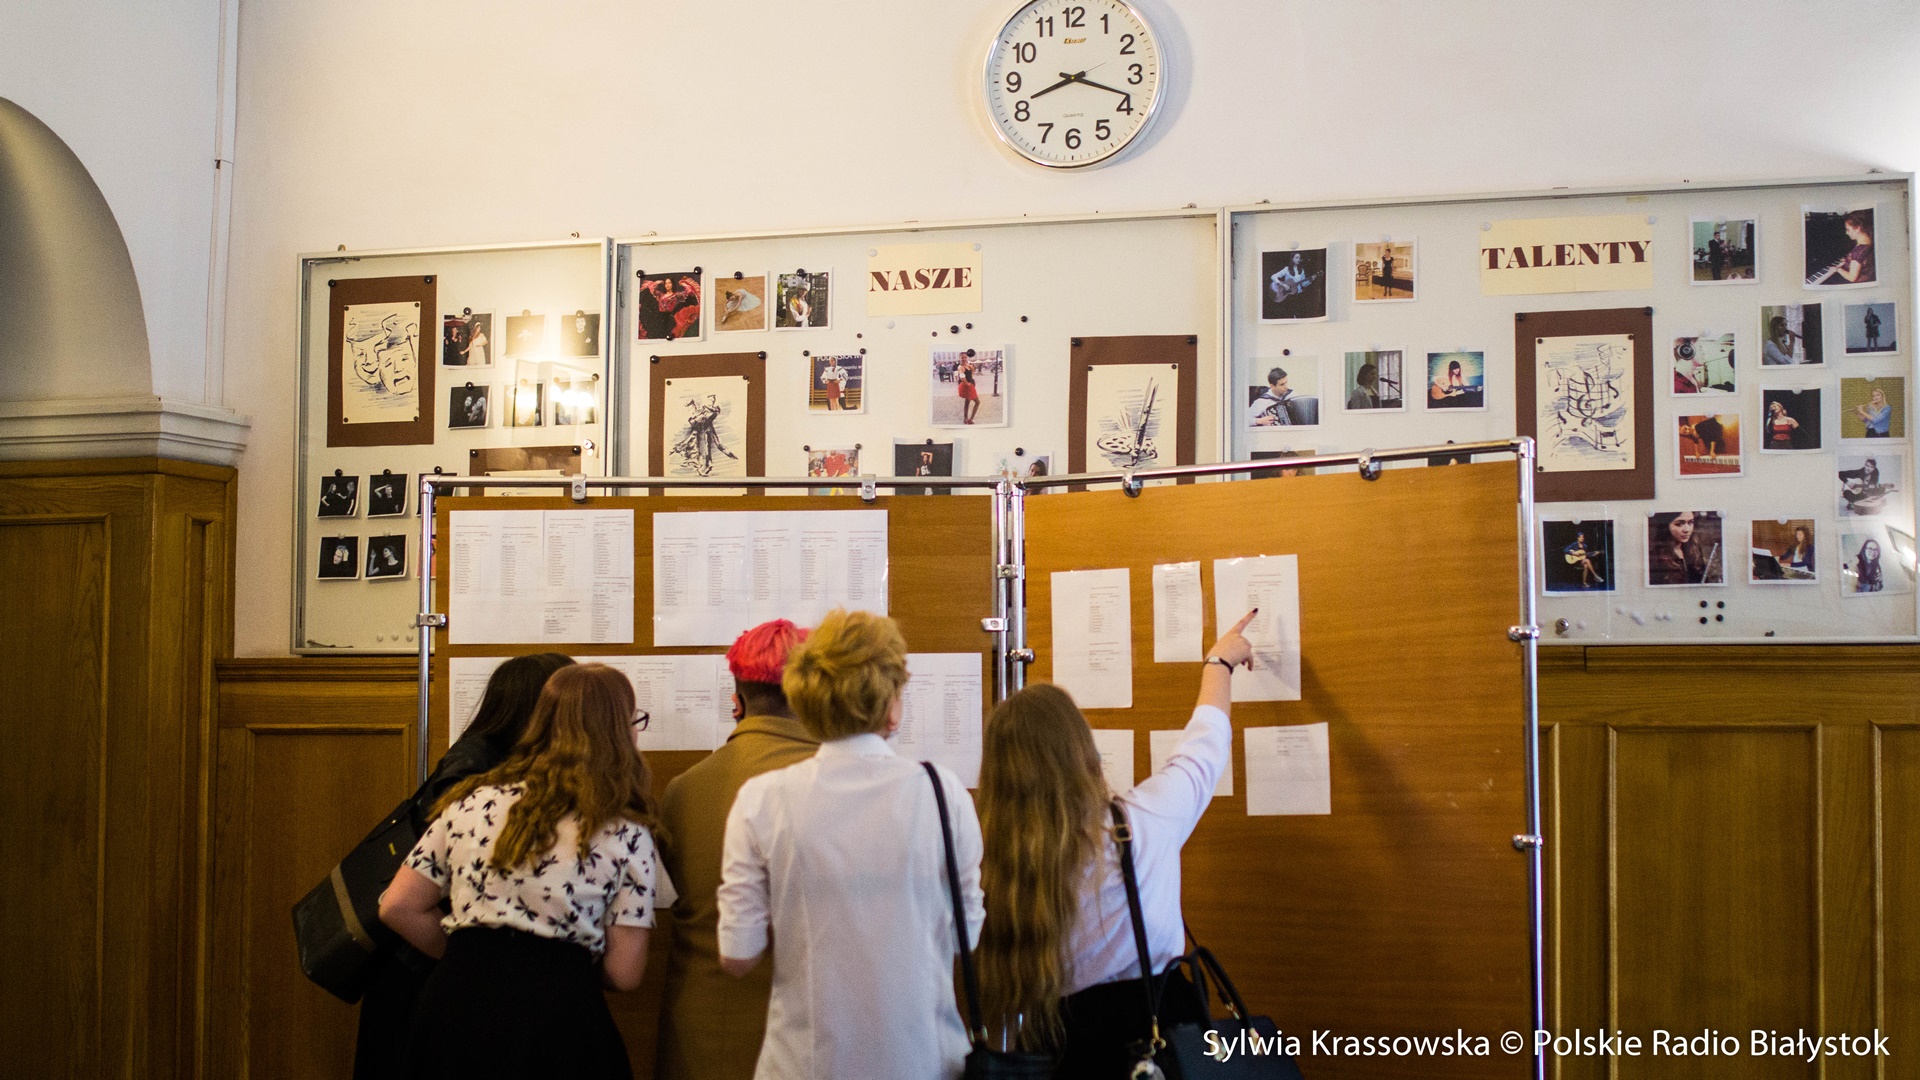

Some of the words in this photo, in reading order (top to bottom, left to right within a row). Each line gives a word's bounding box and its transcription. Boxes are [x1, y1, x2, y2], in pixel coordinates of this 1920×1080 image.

[1036, 16, 1054, 37] 11
[1062, 6, 1086, 29] 12
[1100, 13, 1109, 34] 1
[1012, 41, 1037, 63] 10
[1119, 33, 1136, 55] 2
[1006, 71, 1022, 93] 9
[1127, 63, 1143, 85] 3
[1014, 100, 1031, 122] 8
[1115, 93, 1134, 116] 4
[1037, 122, 1054, 144] 7
[1065, 128, 1082, 149] 6
[1095, 118, 1111, 140] 5
[1482, 240, 1652, 269] TALENTY
[869, 267, 972, 292] NASZE
